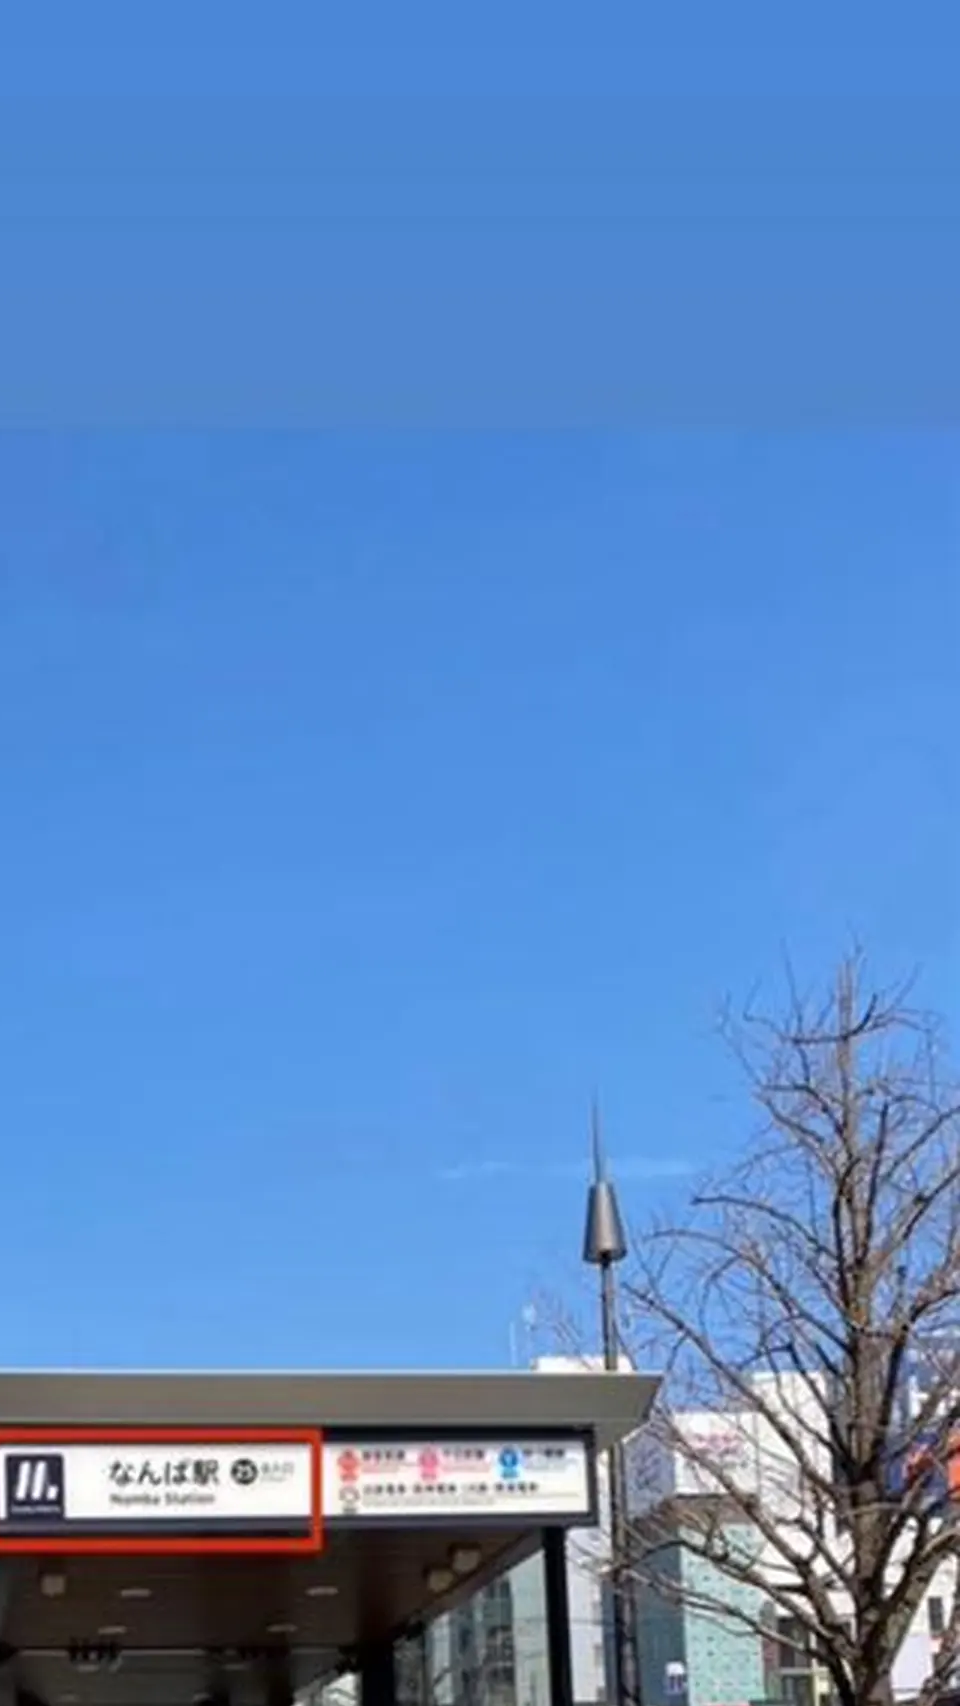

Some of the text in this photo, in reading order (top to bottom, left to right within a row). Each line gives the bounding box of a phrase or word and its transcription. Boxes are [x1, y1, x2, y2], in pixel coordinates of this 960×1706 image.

[108, 1459, 219, 1487] なんば駅
[165, 1492, 216, 1505] Station
